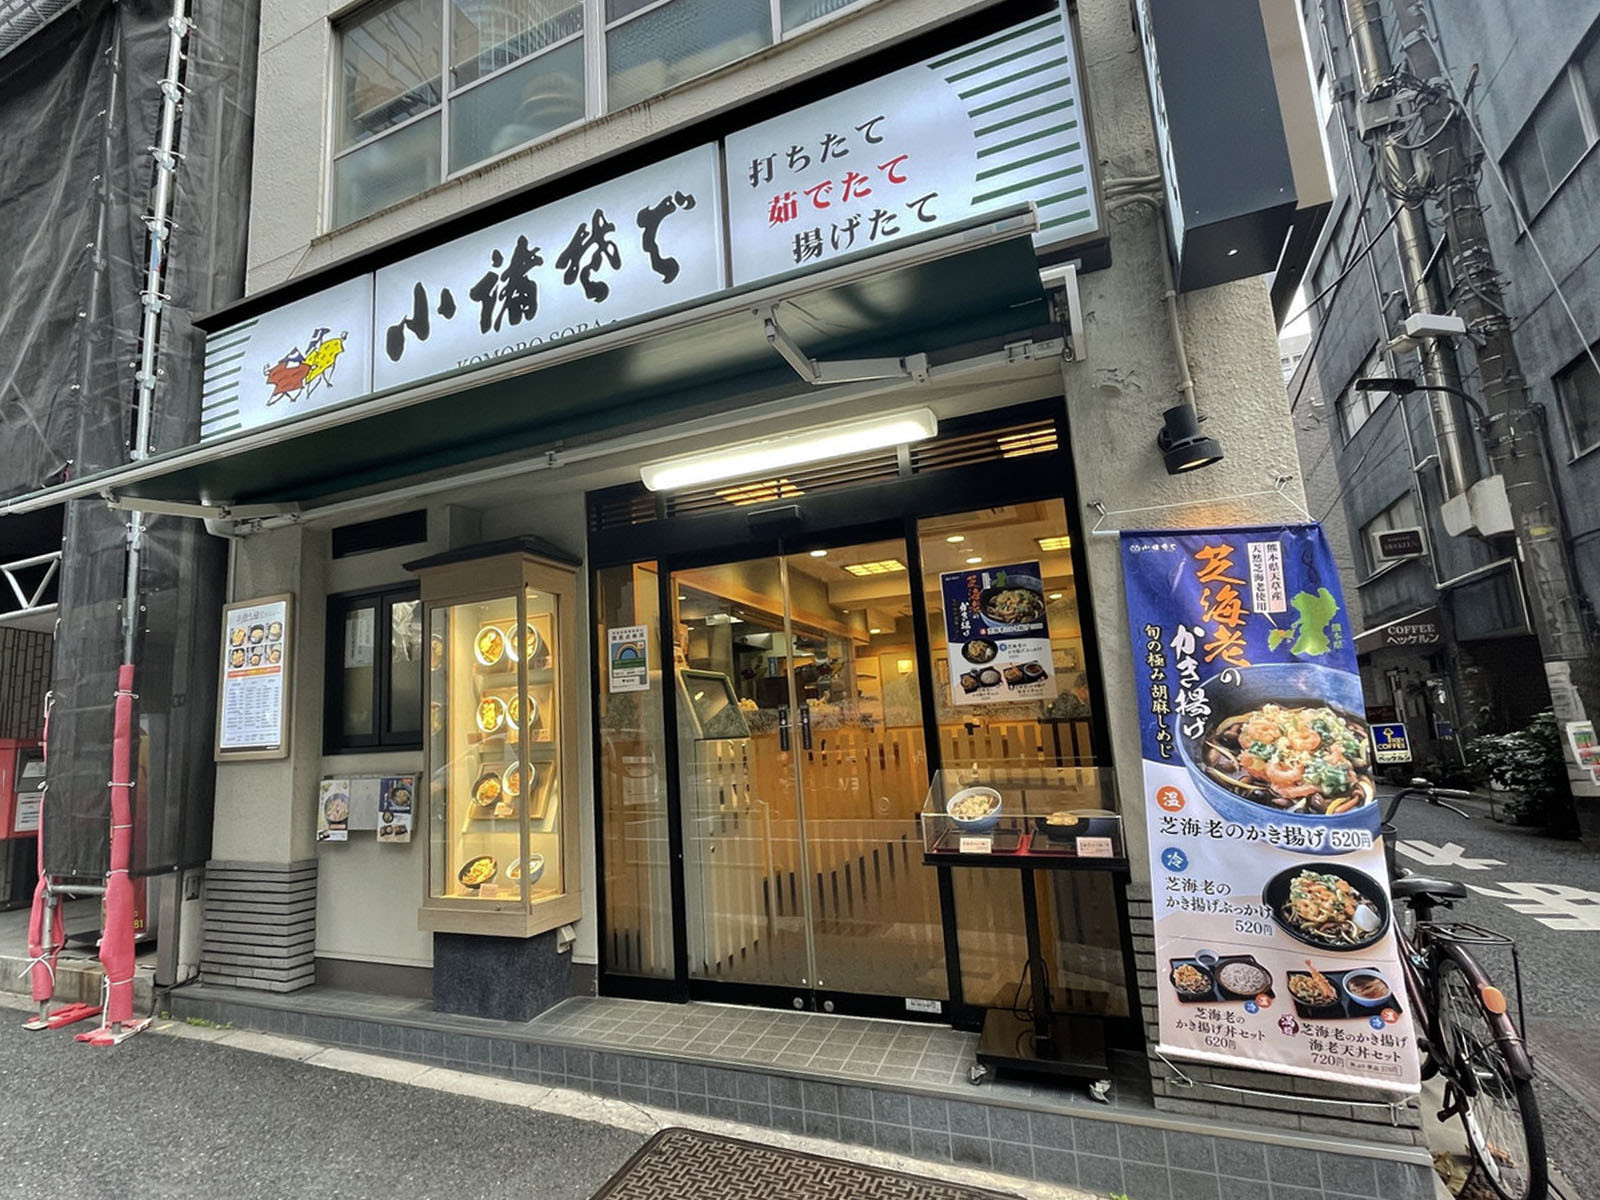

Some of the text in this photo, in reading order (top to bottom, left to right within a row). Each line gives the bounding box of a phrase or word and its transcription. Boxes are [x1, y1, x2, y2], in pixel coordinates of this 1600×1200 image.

[748, 115, 887, 188] 打ちたて
[767, 154, 910, 228] 茹でたて
[791, 192, 939, 264] 揚げたて
[1387, 624, 1436, 634] COFFEE
[1387, 634, 1440, 645] ヘッケルン
[1170, 624, 1211, 739] かき揚げ
[1159, 816, 1325, 848] 芝海老のかき揚げ
[1165, 876, 1231, 896] 芝海老の
[1166, 895, 1273, 919] かき揚げぶっかけ
[1194, 1007, 1245, 1025] 芝海老の
[1301, 1023, 1408, 1048] 芝海老のかき揚げ
